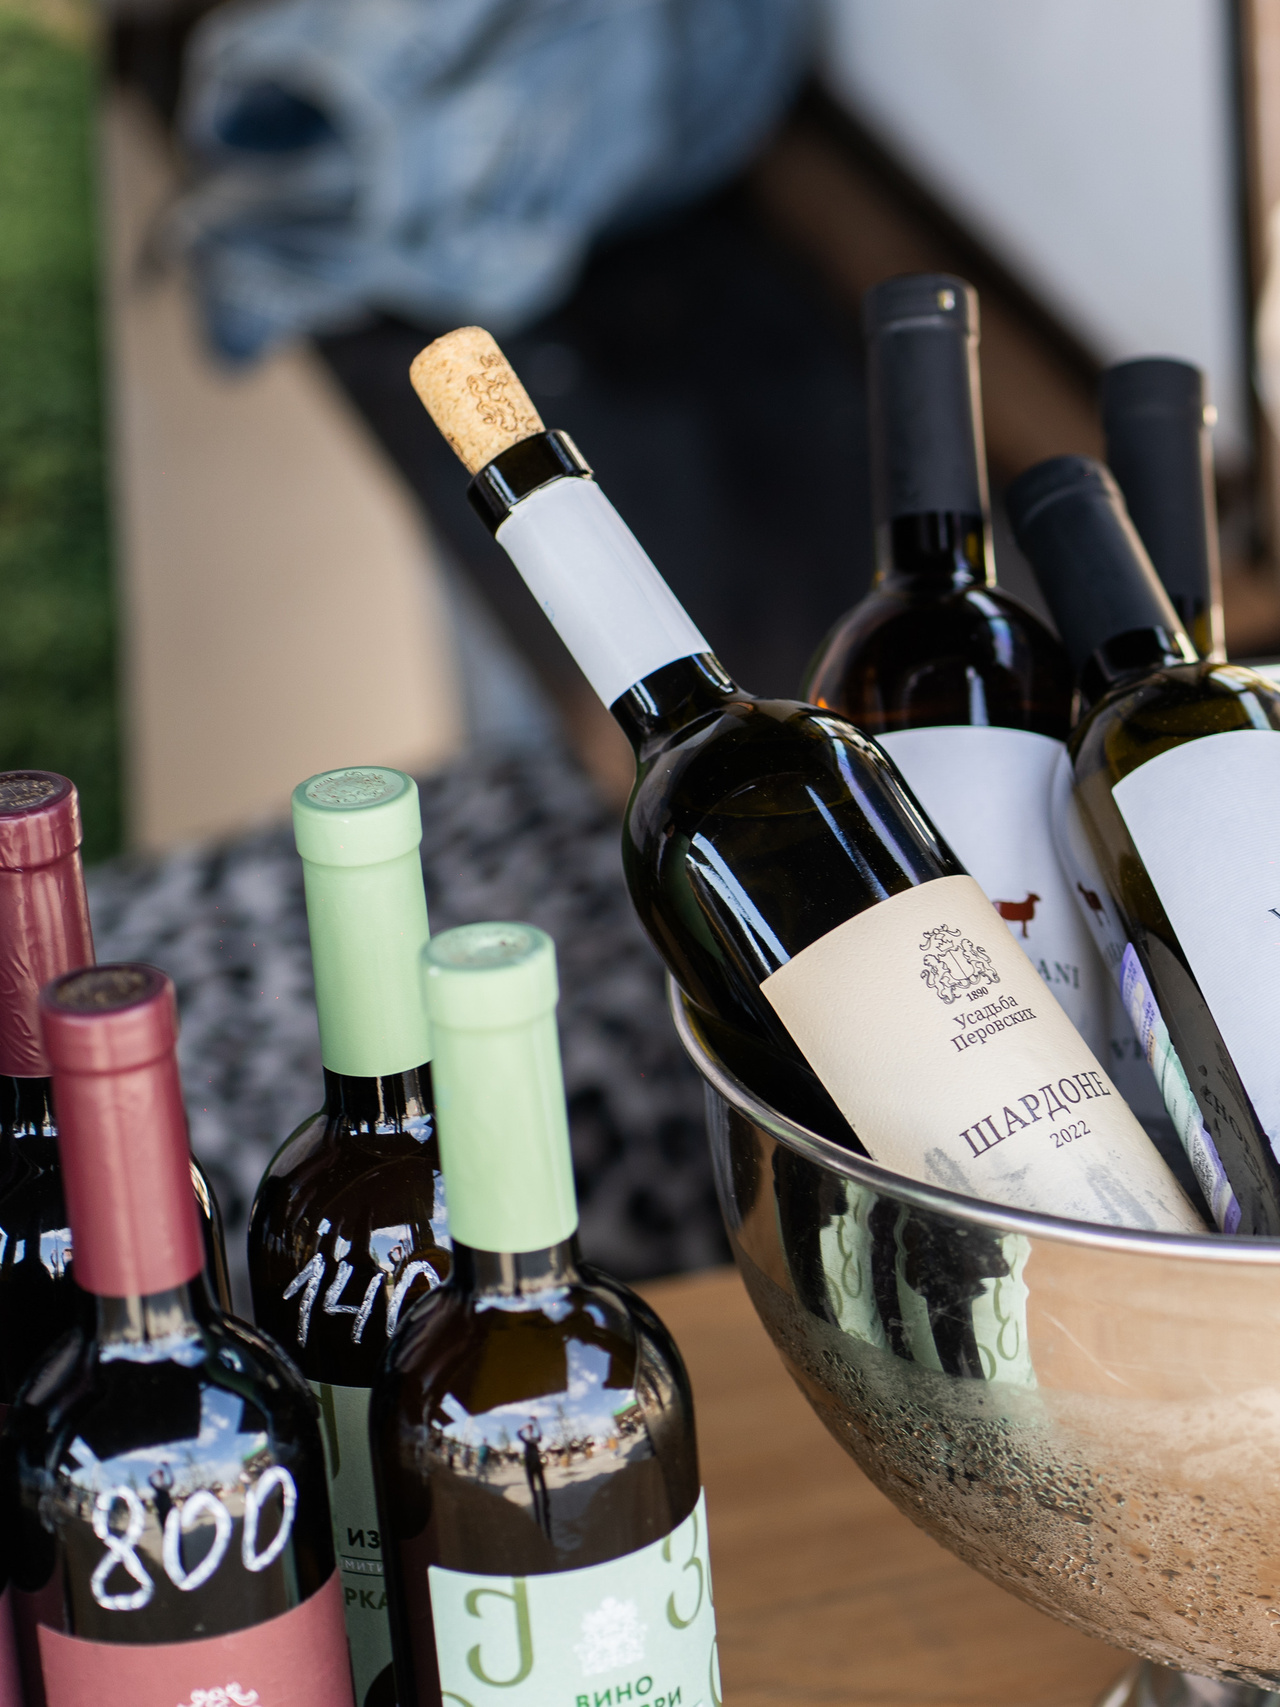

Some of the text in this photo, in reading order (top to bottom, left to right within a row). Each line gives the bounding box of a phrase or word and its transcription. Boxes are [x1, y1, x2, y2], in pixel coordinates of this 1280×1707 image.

[953, 995, 1019, 1030] Усадьба
[966, 986, 989, 1002] 1890
[950, 1008, 1037, 1052] Перовских
[959, 1071, 1112, 1158] ШАРДОНЕ
[1049, 1120, 1091, 1148] 2022
[91, 1466, 297, 1611] 800
